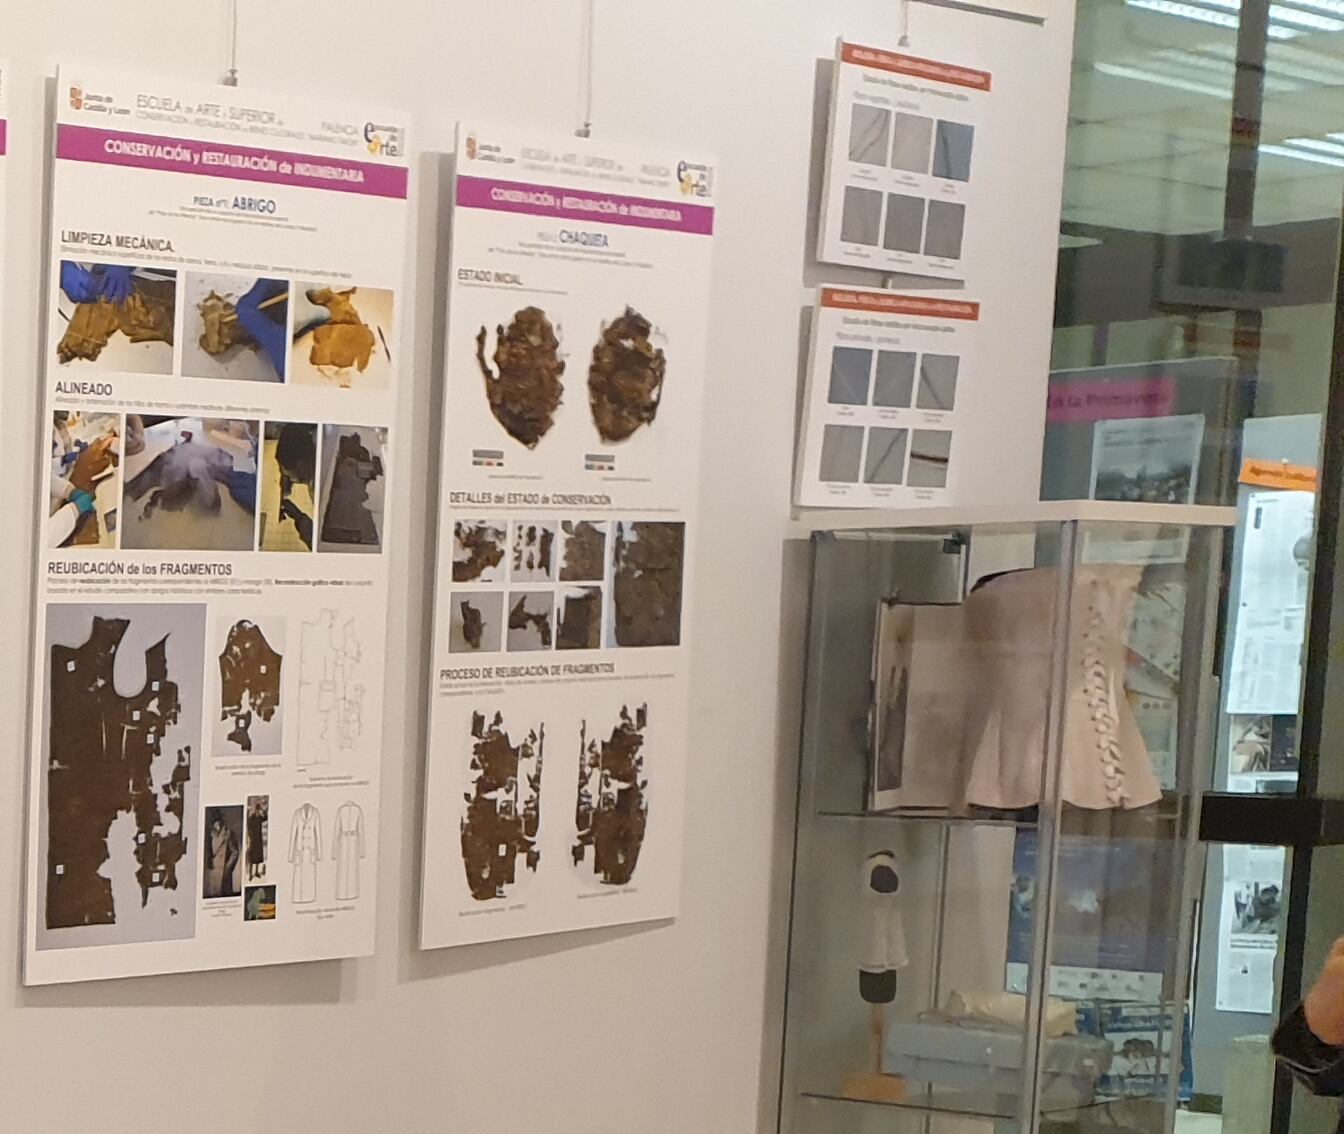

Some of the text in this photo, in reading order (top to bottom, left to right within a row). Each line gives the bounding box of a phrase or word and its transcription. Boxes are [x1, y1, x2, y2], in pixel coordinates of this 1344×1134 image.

[104, 139, 192, 162] CONSERVACIÓN
[193, 152, 201, 166] y
[278, 160, 293, 175] de
[231, 196, 277, 215] ABRIGO
[61, 229, 113, 247] LIMPIEZA
[54, 380, 113, 396] ALINEADO
[47, 559, 232, 577] REUBICACIÓN de los FRAGMENTOS
